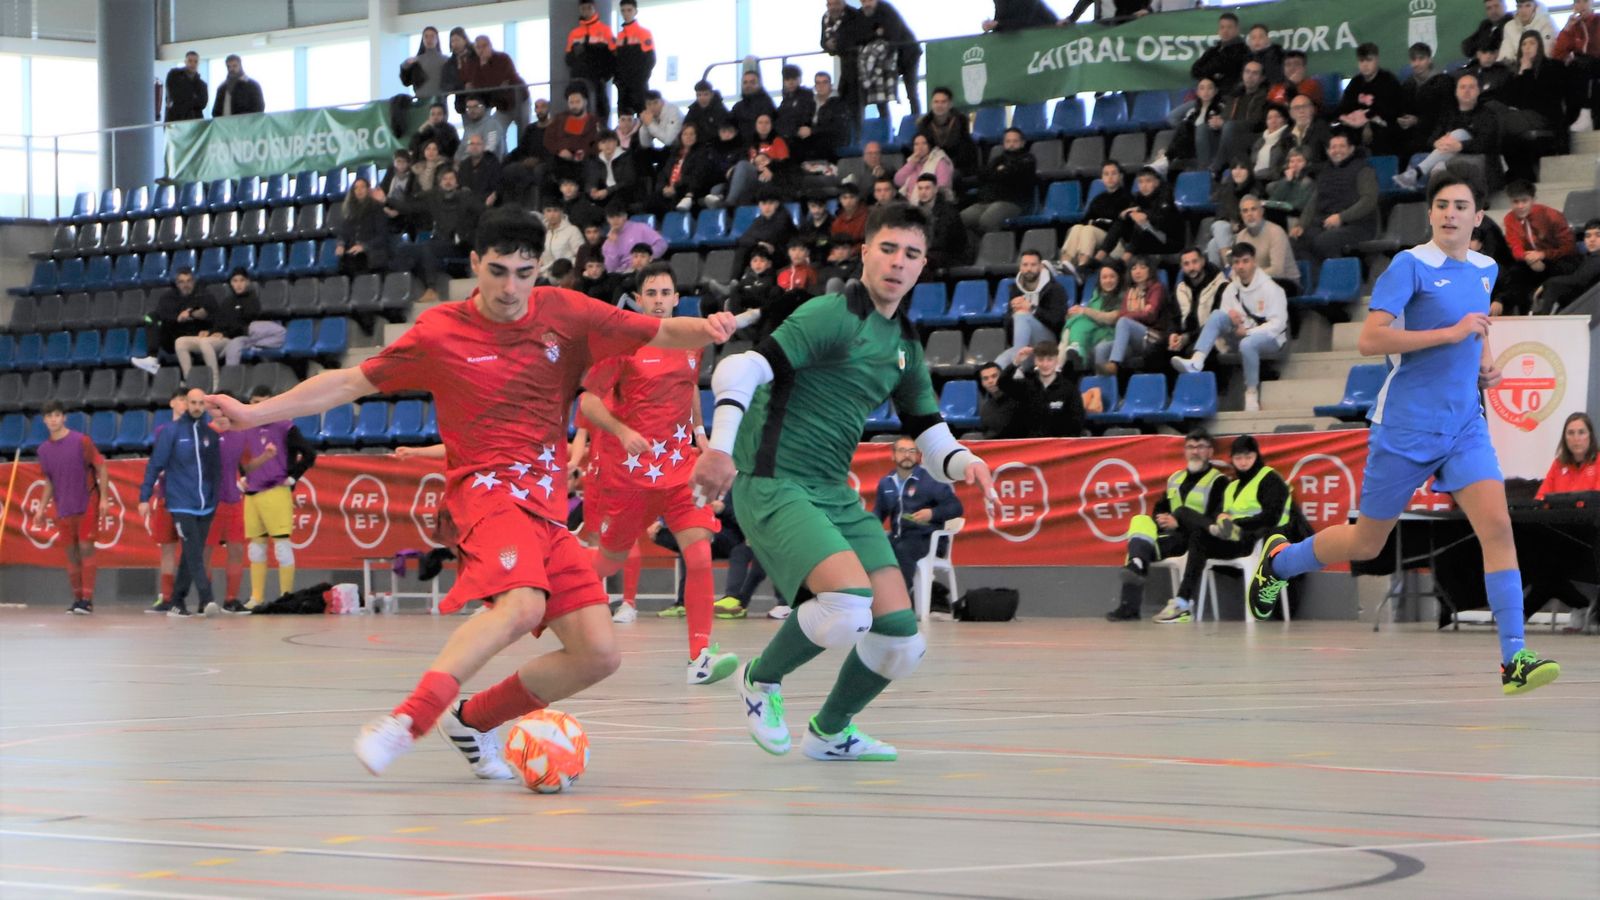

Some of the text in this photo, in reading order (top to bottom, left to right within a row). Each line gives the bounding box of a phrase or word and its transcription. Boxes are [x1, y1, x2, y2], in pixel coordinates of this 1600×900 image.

[1027, 36, 1131, 74] LATERAL
[1335, 22, 1359, 49] A
[207, 138, 267, 163] FONDO
[305, 128, 370, 157] SECOR
[1001, 480, 1034, 498] RF
[1094, 481, 1130, 497] RF
[1300, 475, 1340, 494] RF
[351, 493, 378, 508] RF
[1001, 505, 1034, 522] EF
[1093, 502, 1131, 519] EF
[1302, 502, 1339, 522] EF
[355, 514, 380, 529] EF
[422, 514, 436, 528] E
